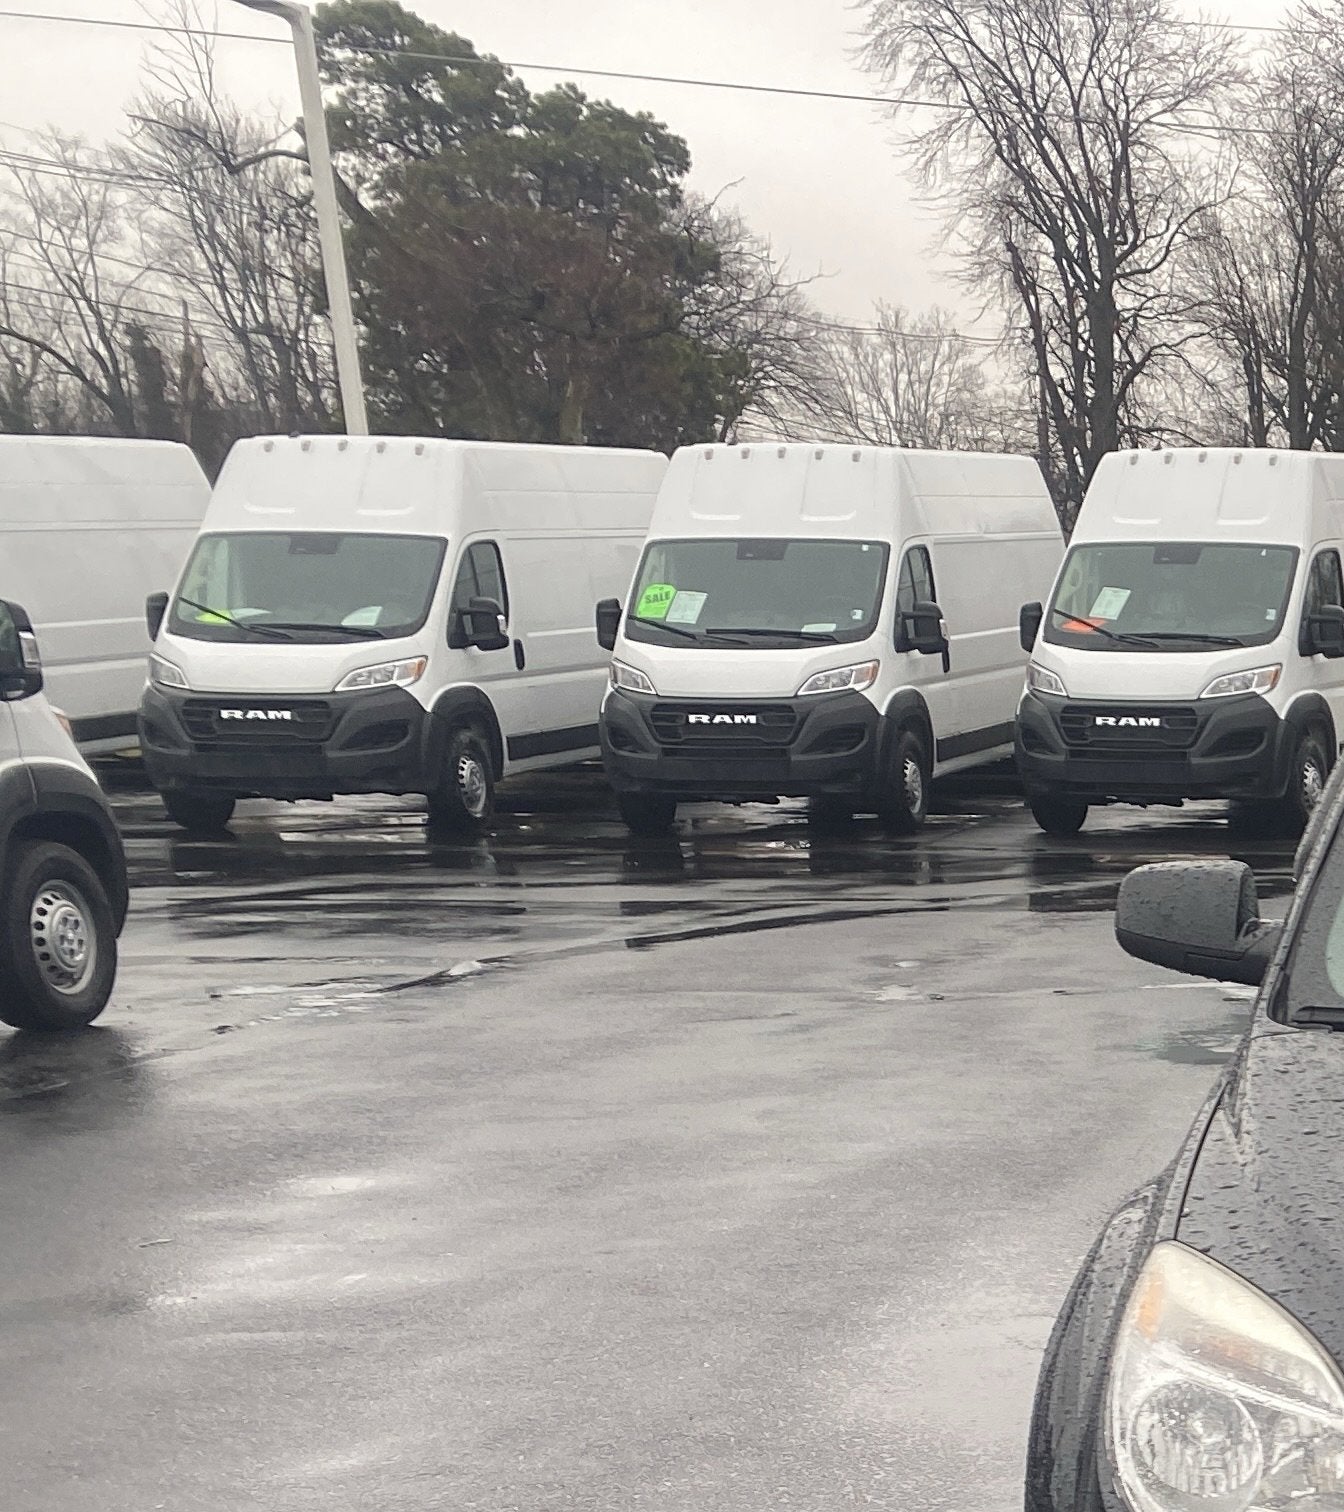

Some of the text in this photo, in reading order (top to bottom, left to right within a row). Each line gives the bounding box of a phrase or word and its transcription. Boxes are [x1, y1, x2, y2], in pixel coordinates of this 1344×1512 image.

[219, 709, 292, 721] RAM
[688, 714, 757, 725] RAM
[1095, 716, 1161, 728] RAM
